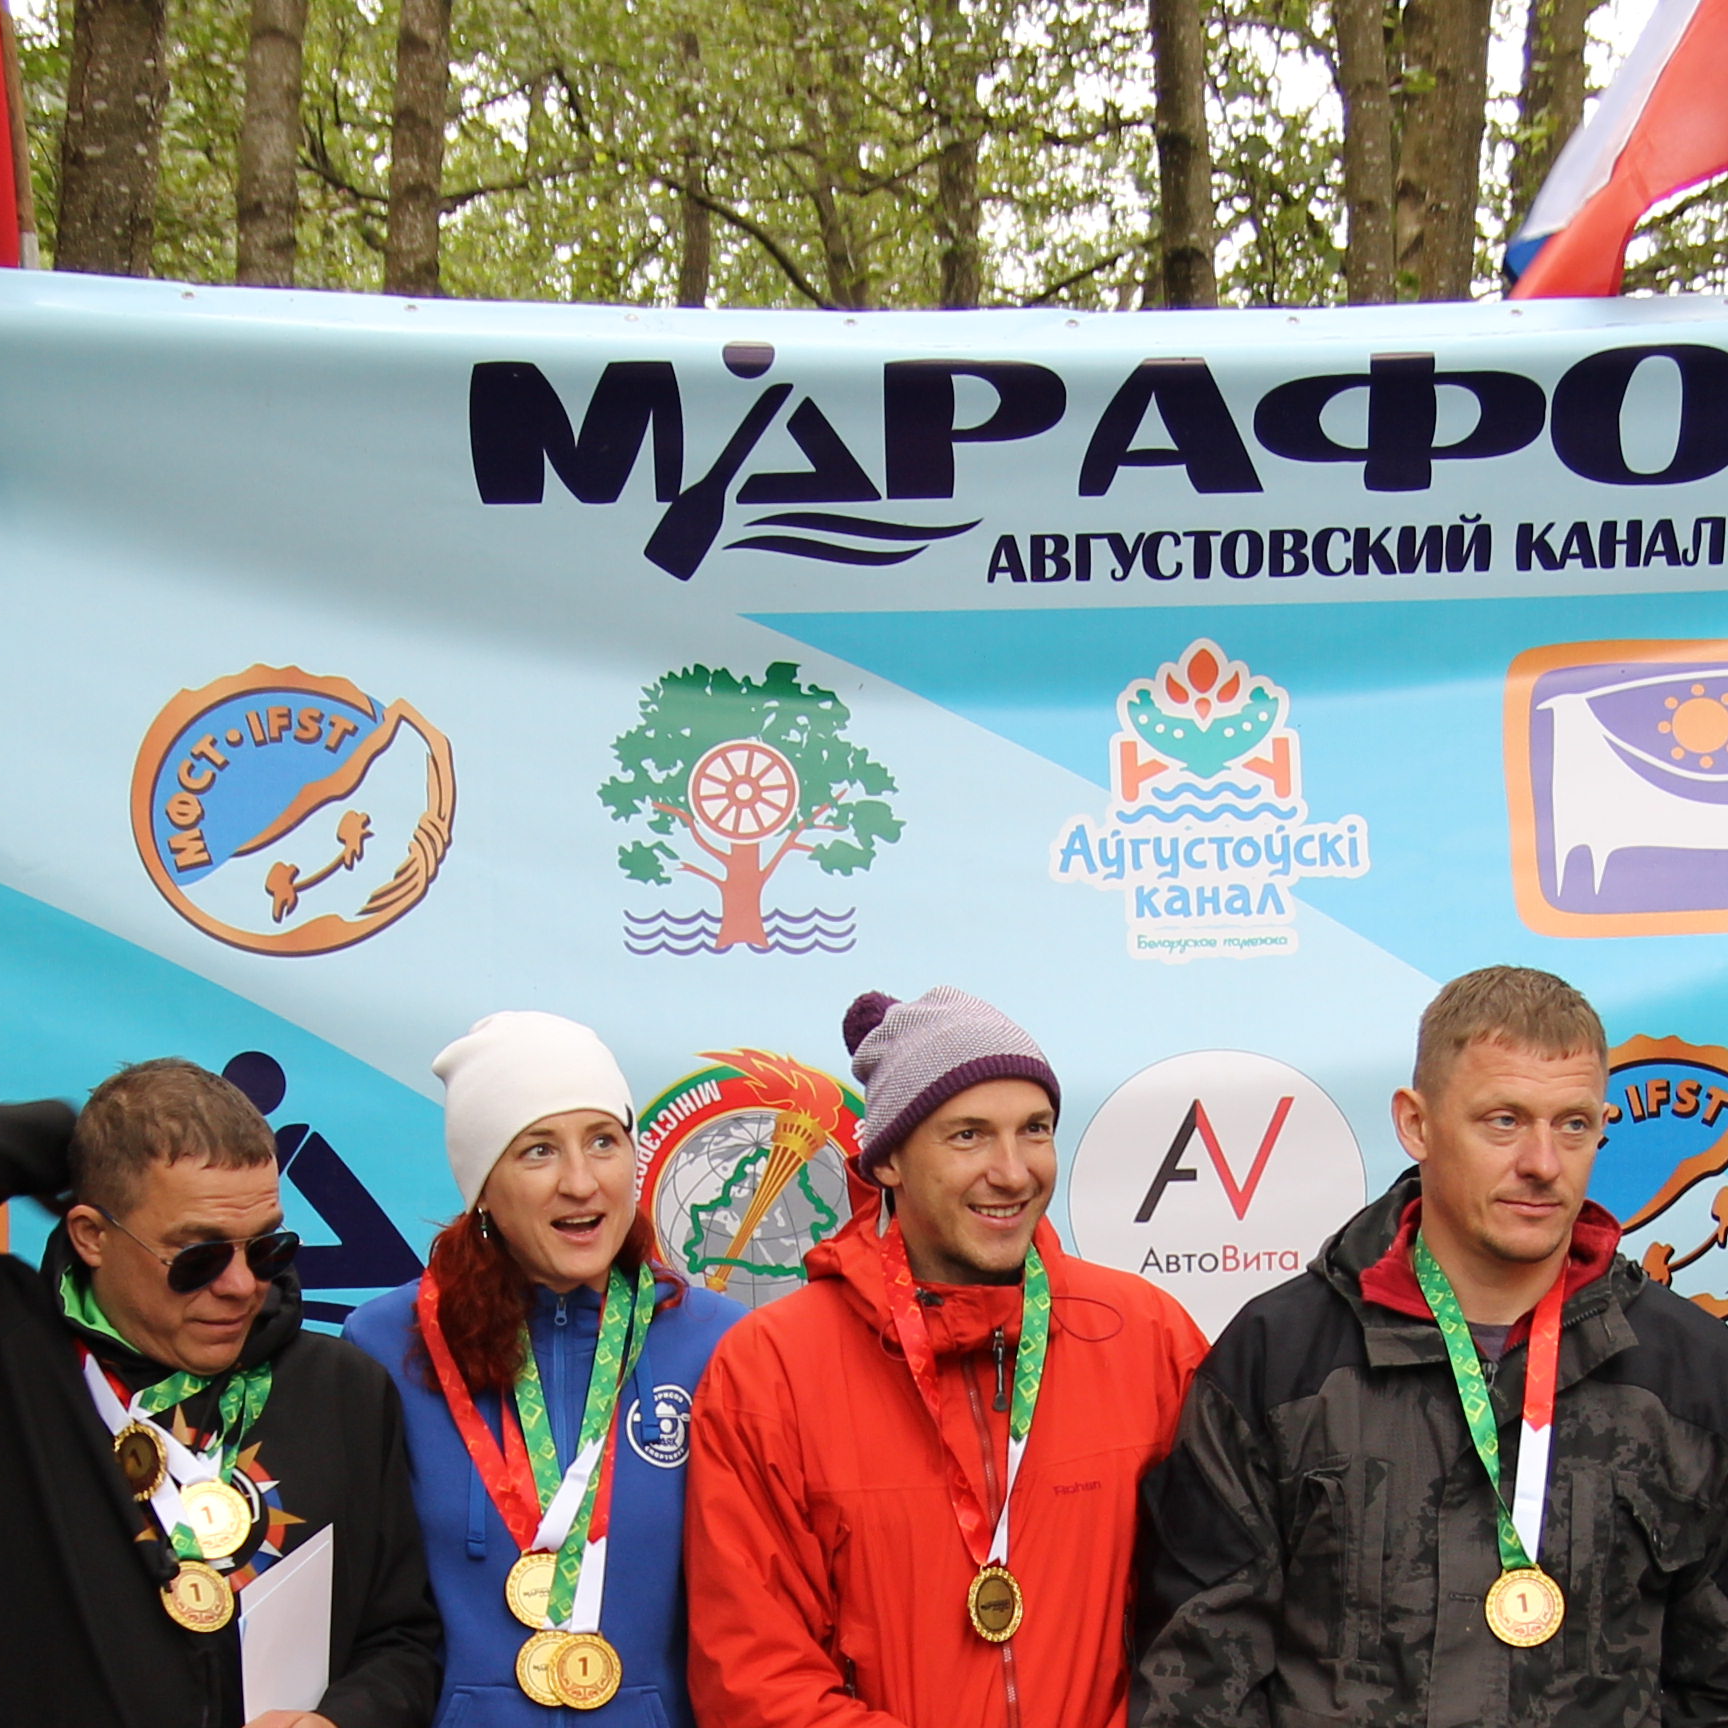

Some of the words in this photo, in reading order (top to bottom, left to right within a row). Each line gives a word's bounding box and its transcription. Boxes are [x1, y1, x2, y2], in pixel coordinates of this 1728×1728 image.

[987, 515, 1493, 584] АВГУСТОВСКИЙ
[1515, 515, 1727, 572] КАНАЛ
[245, 706, 359, 754] IFST
[1059, 824, 1360, 880] Аўгустоўскі
[1135, 883, 1285, 918] канал
[1140, 1245, 1299, 1274] АвтоВита
[200, 1505, 214, 1525] 1
[188, 1582, 203, 1603] 1
[1516, 1592, 1528, 1613] 1
[577, 1655, 589, 1678] 1
